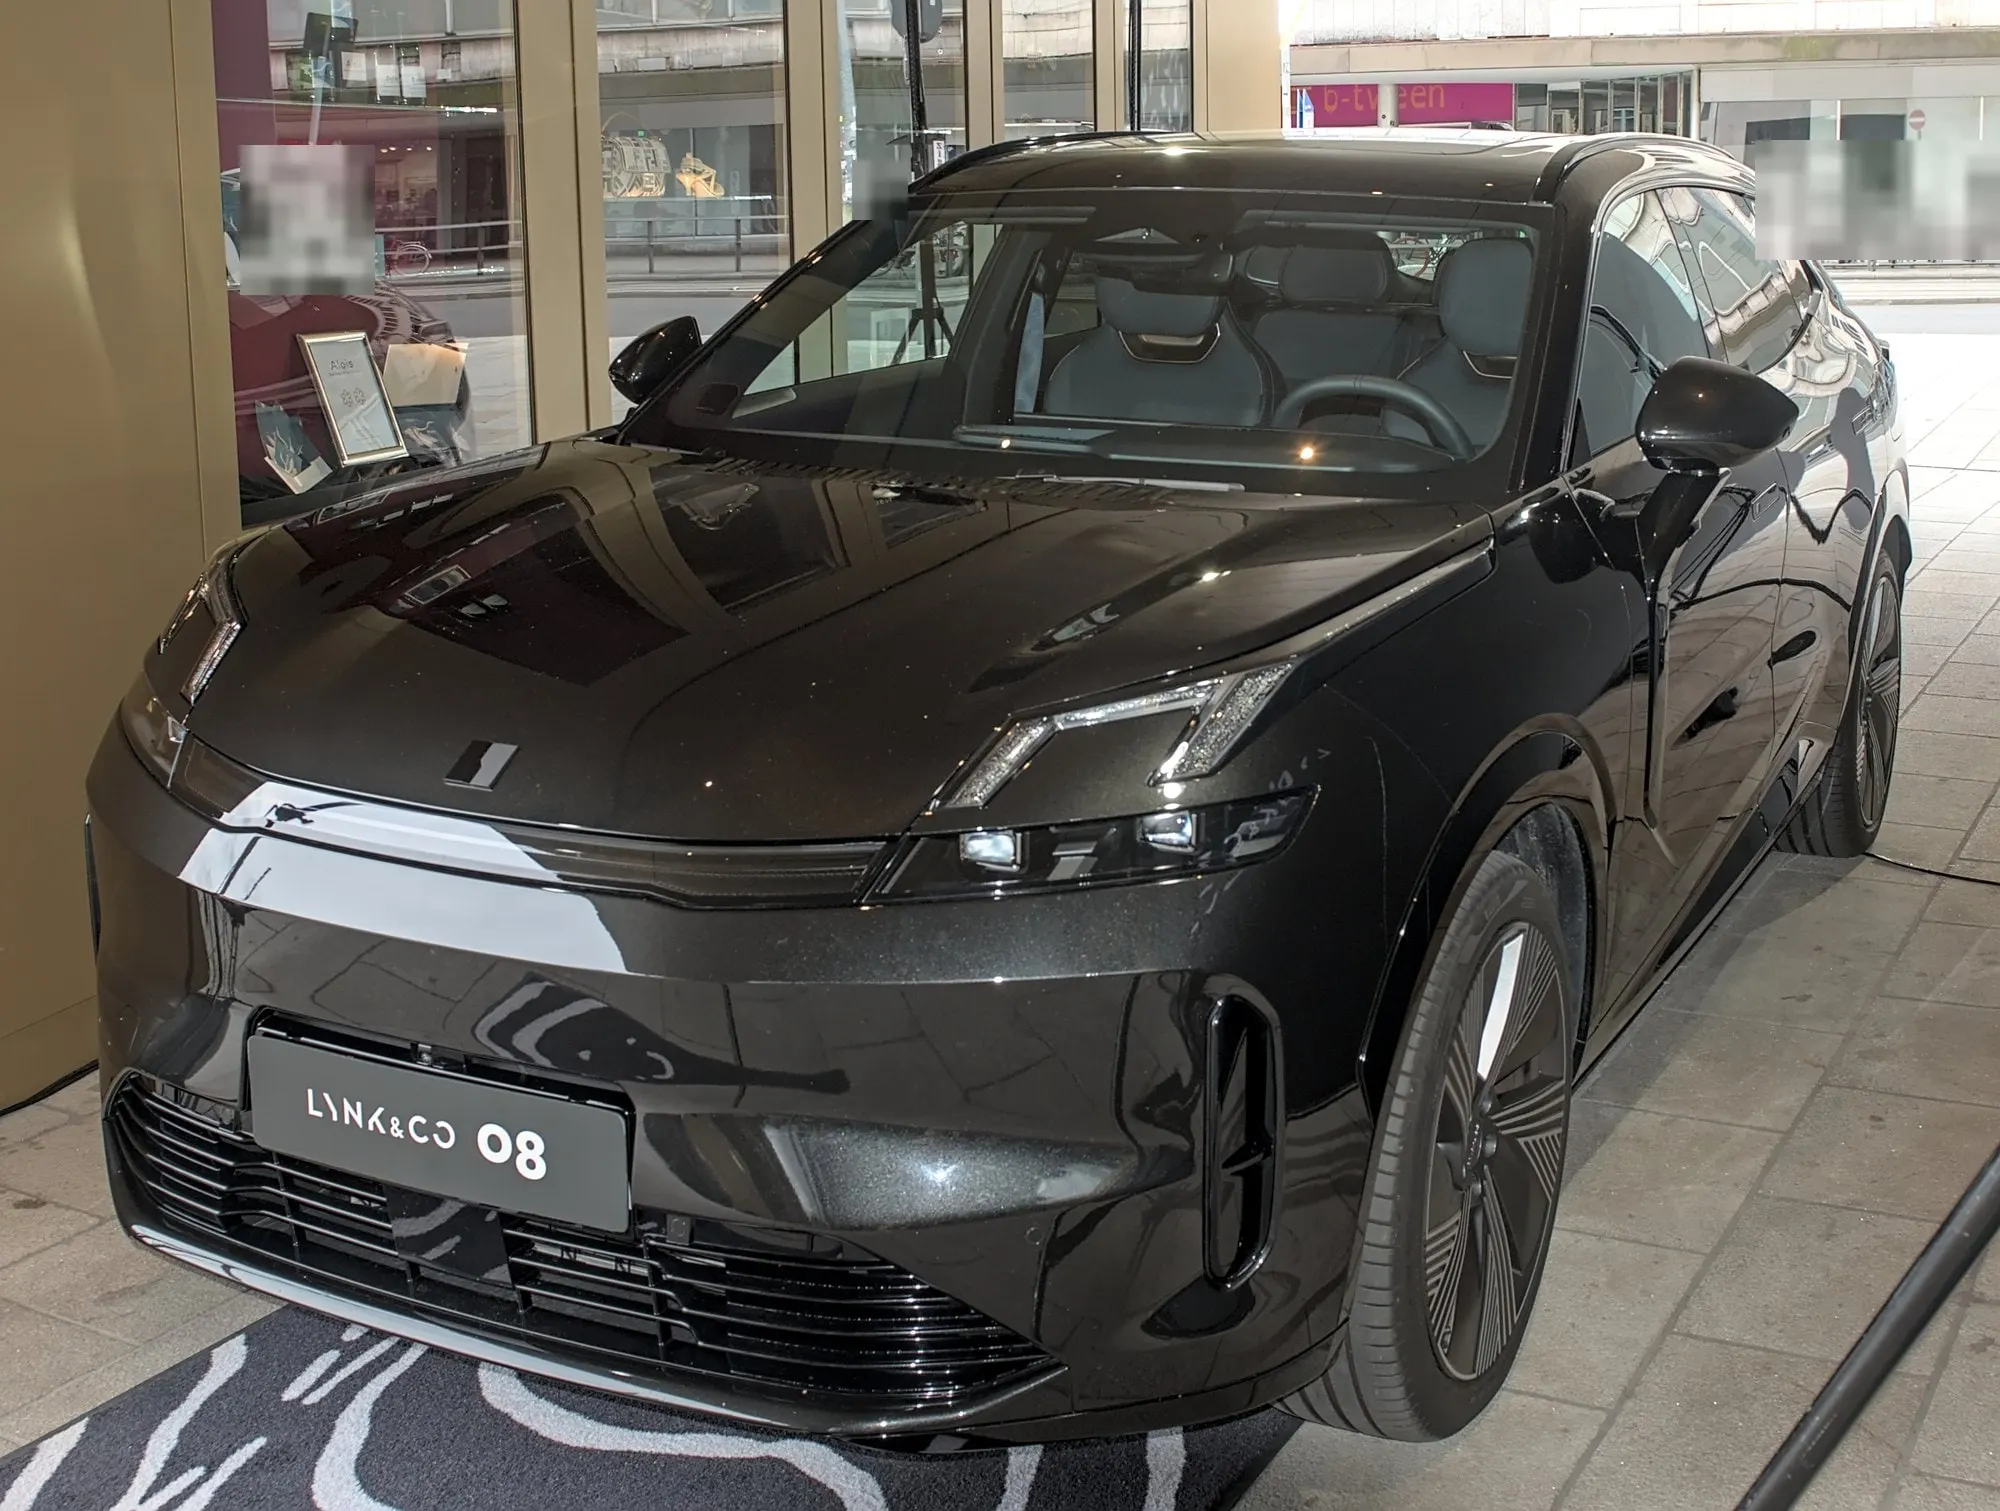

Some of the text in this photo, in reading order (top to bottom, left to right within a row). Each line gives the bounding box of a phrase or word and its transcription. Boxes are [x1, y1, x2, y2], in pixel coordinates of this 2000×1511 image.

[331, 360, 354, 370] Alois
[307, 1088, 547, 1181] LYNK&CO 08
